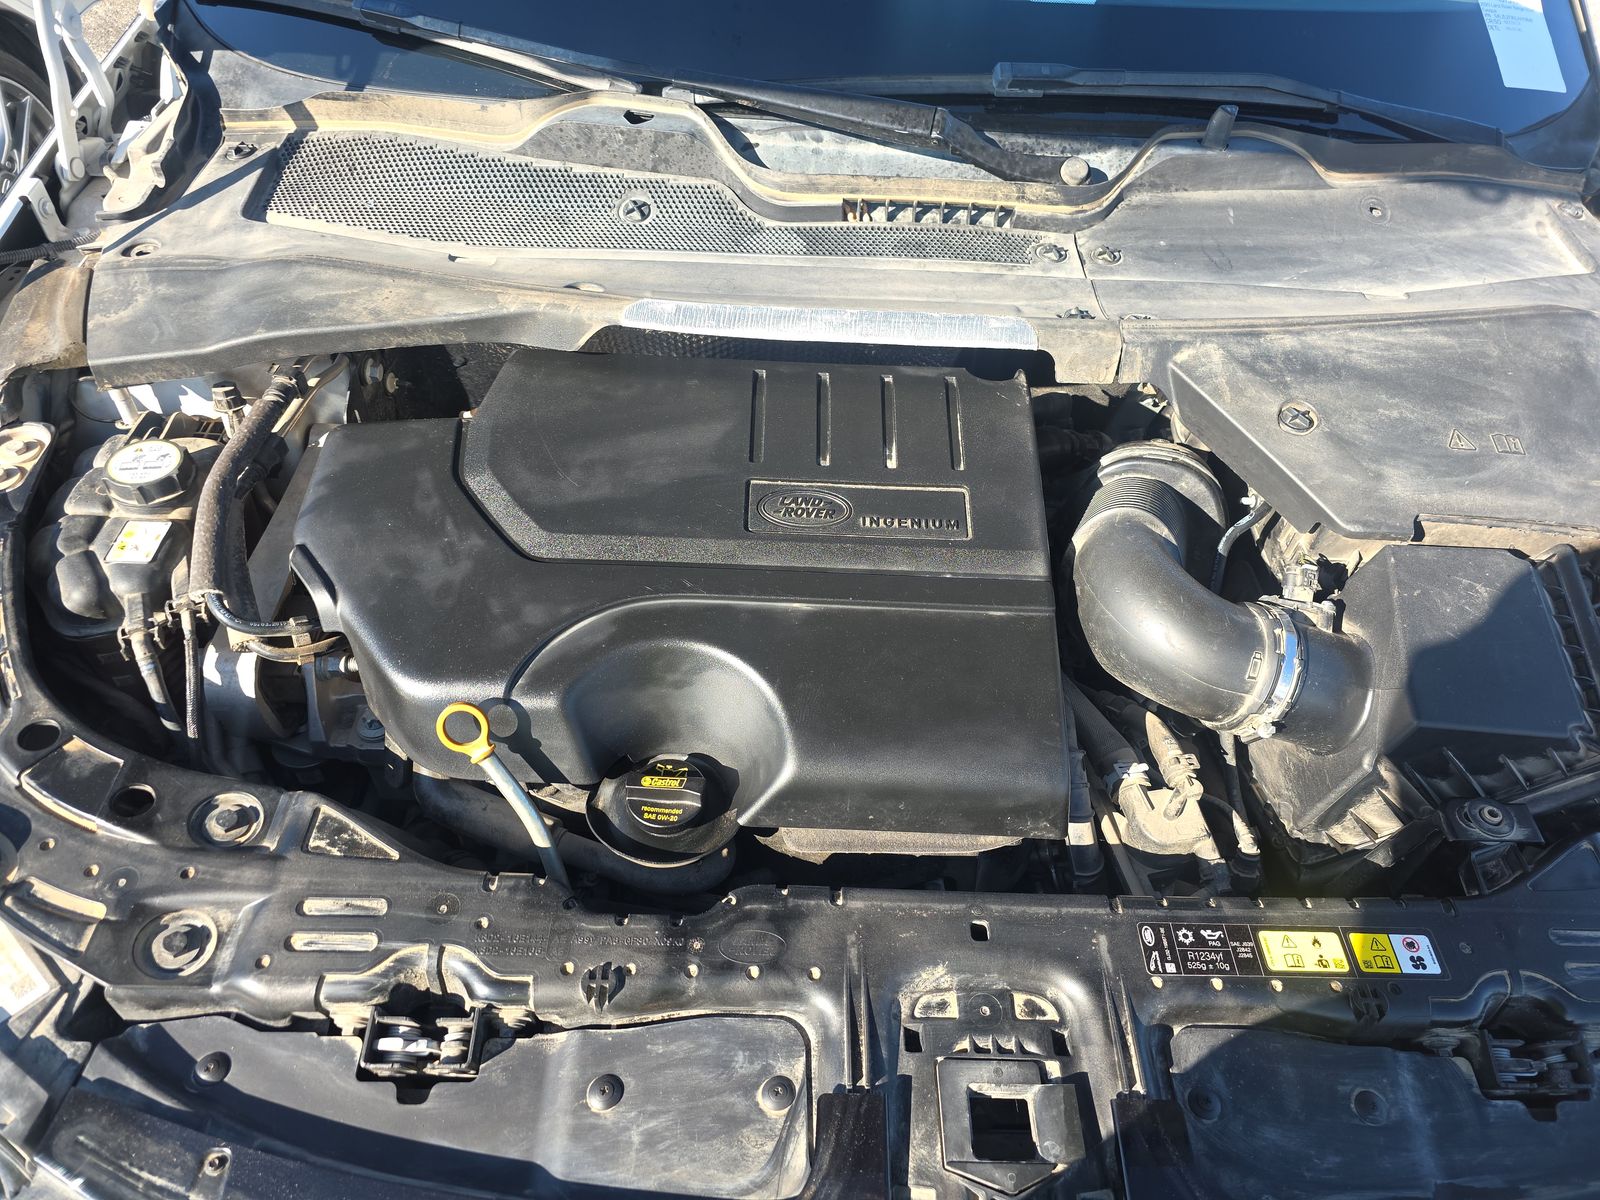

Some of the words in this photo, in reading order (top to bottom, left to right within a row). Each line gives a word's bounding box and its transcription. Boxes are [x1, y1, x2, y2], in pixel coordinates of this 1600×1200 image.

[782, 507, 836, 519] ROVER
[860, 516, 960, 530] INGENIUM
[651, 777, 681, 787] Castrol
[641, 805, 683, 815] recommended
[643, 812, 656, 820] SAE
[657, 814, 678, 822] 0W-20
[1187, 951, 1224, 963] R1234yf
[1187, 962, 1207, 970] 525g
[1216, 962, 1230, 971] 10g
